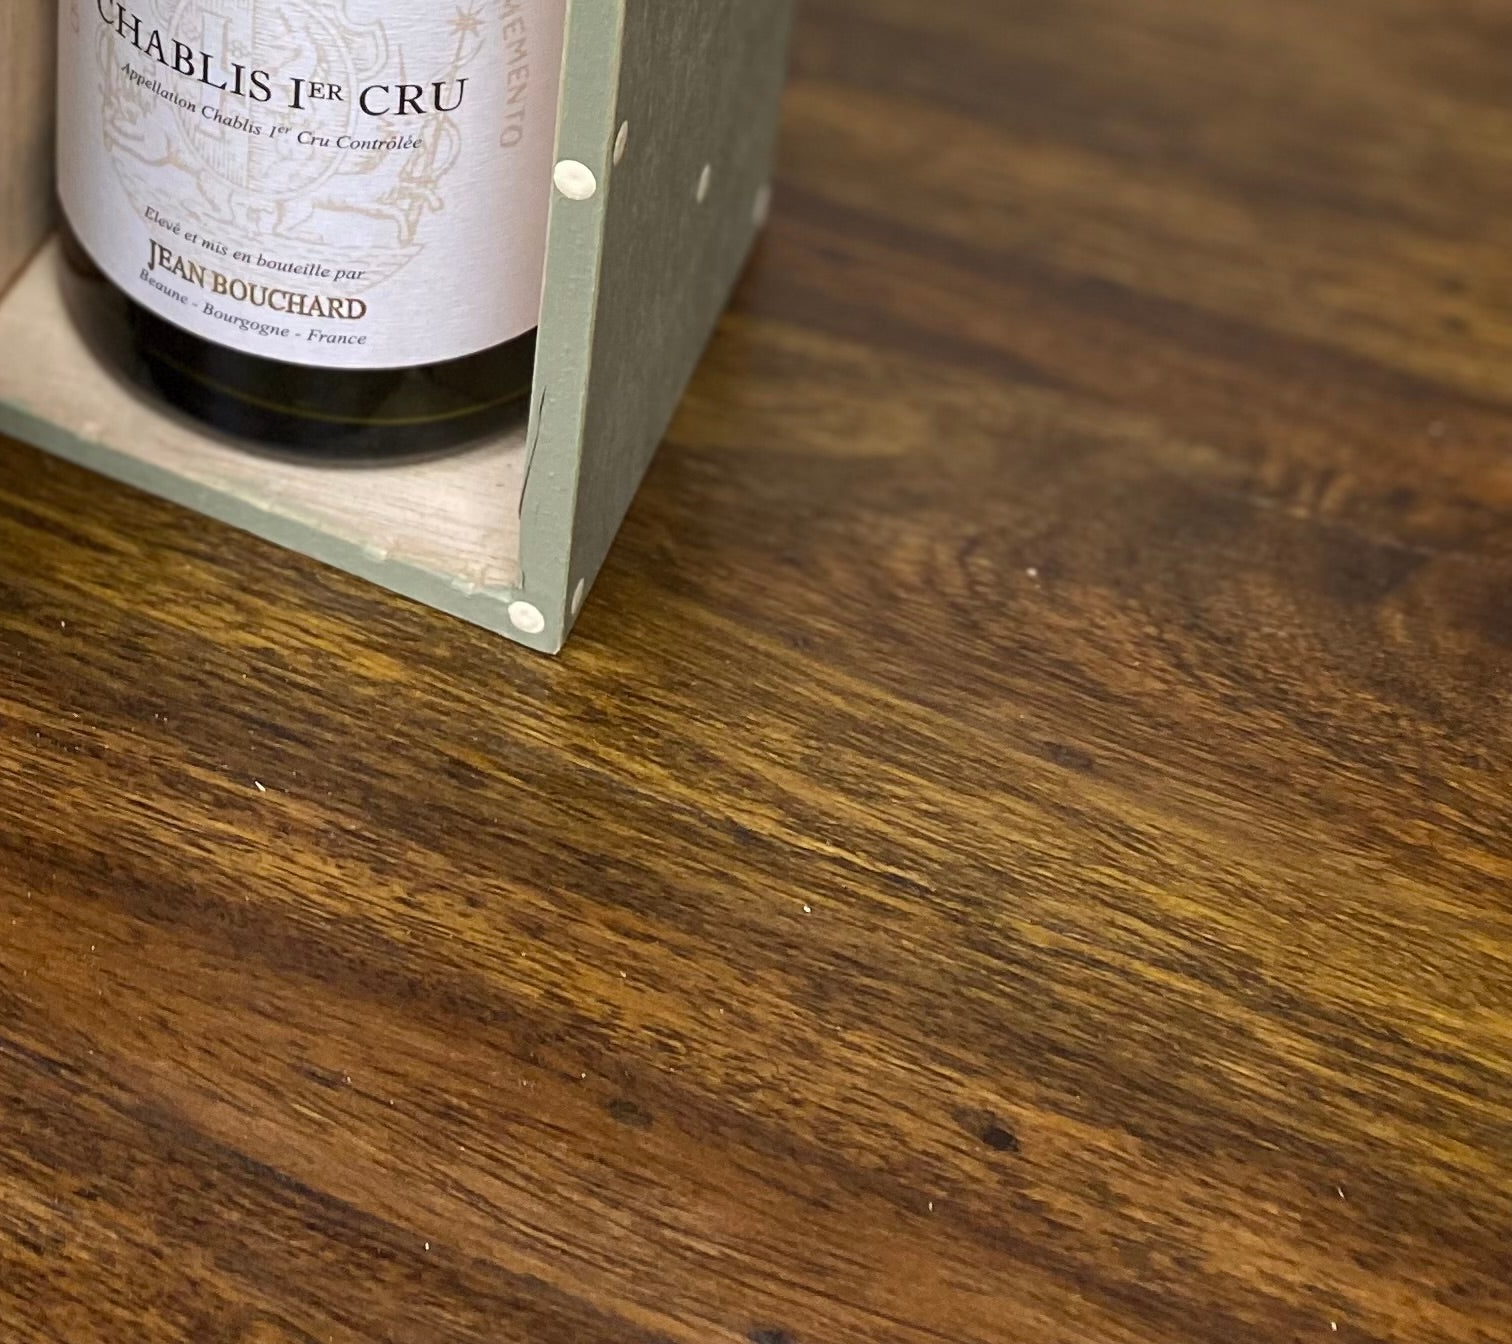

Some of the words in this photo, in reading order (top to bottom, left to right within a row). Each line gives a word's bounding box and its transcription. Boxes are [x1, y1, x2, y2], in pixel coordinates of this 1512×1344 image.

[121, 63, 196, 113] Appellation
[201, 105, 262, 136] Chablis
[297, 130, 329, 148] Cru
[336, 134, 423, 151] Contrôlée
[359, 78, 469, 116] CRU
[148, 238, 206, 289] JEAN
[211, 269, 368, 321] BOUCHARD
[184, 231, 198, 244] et
[202, 240, 229, 256] mis
[232, 250, 252, 263] en
[256, 253, 331, 279] bouteille
[333, 268, 366, 282] par
[138, 268, 189, 305] Beaune
[202, 301, 291, 338] Bourgogne
[306, 328, 368, 346] France
